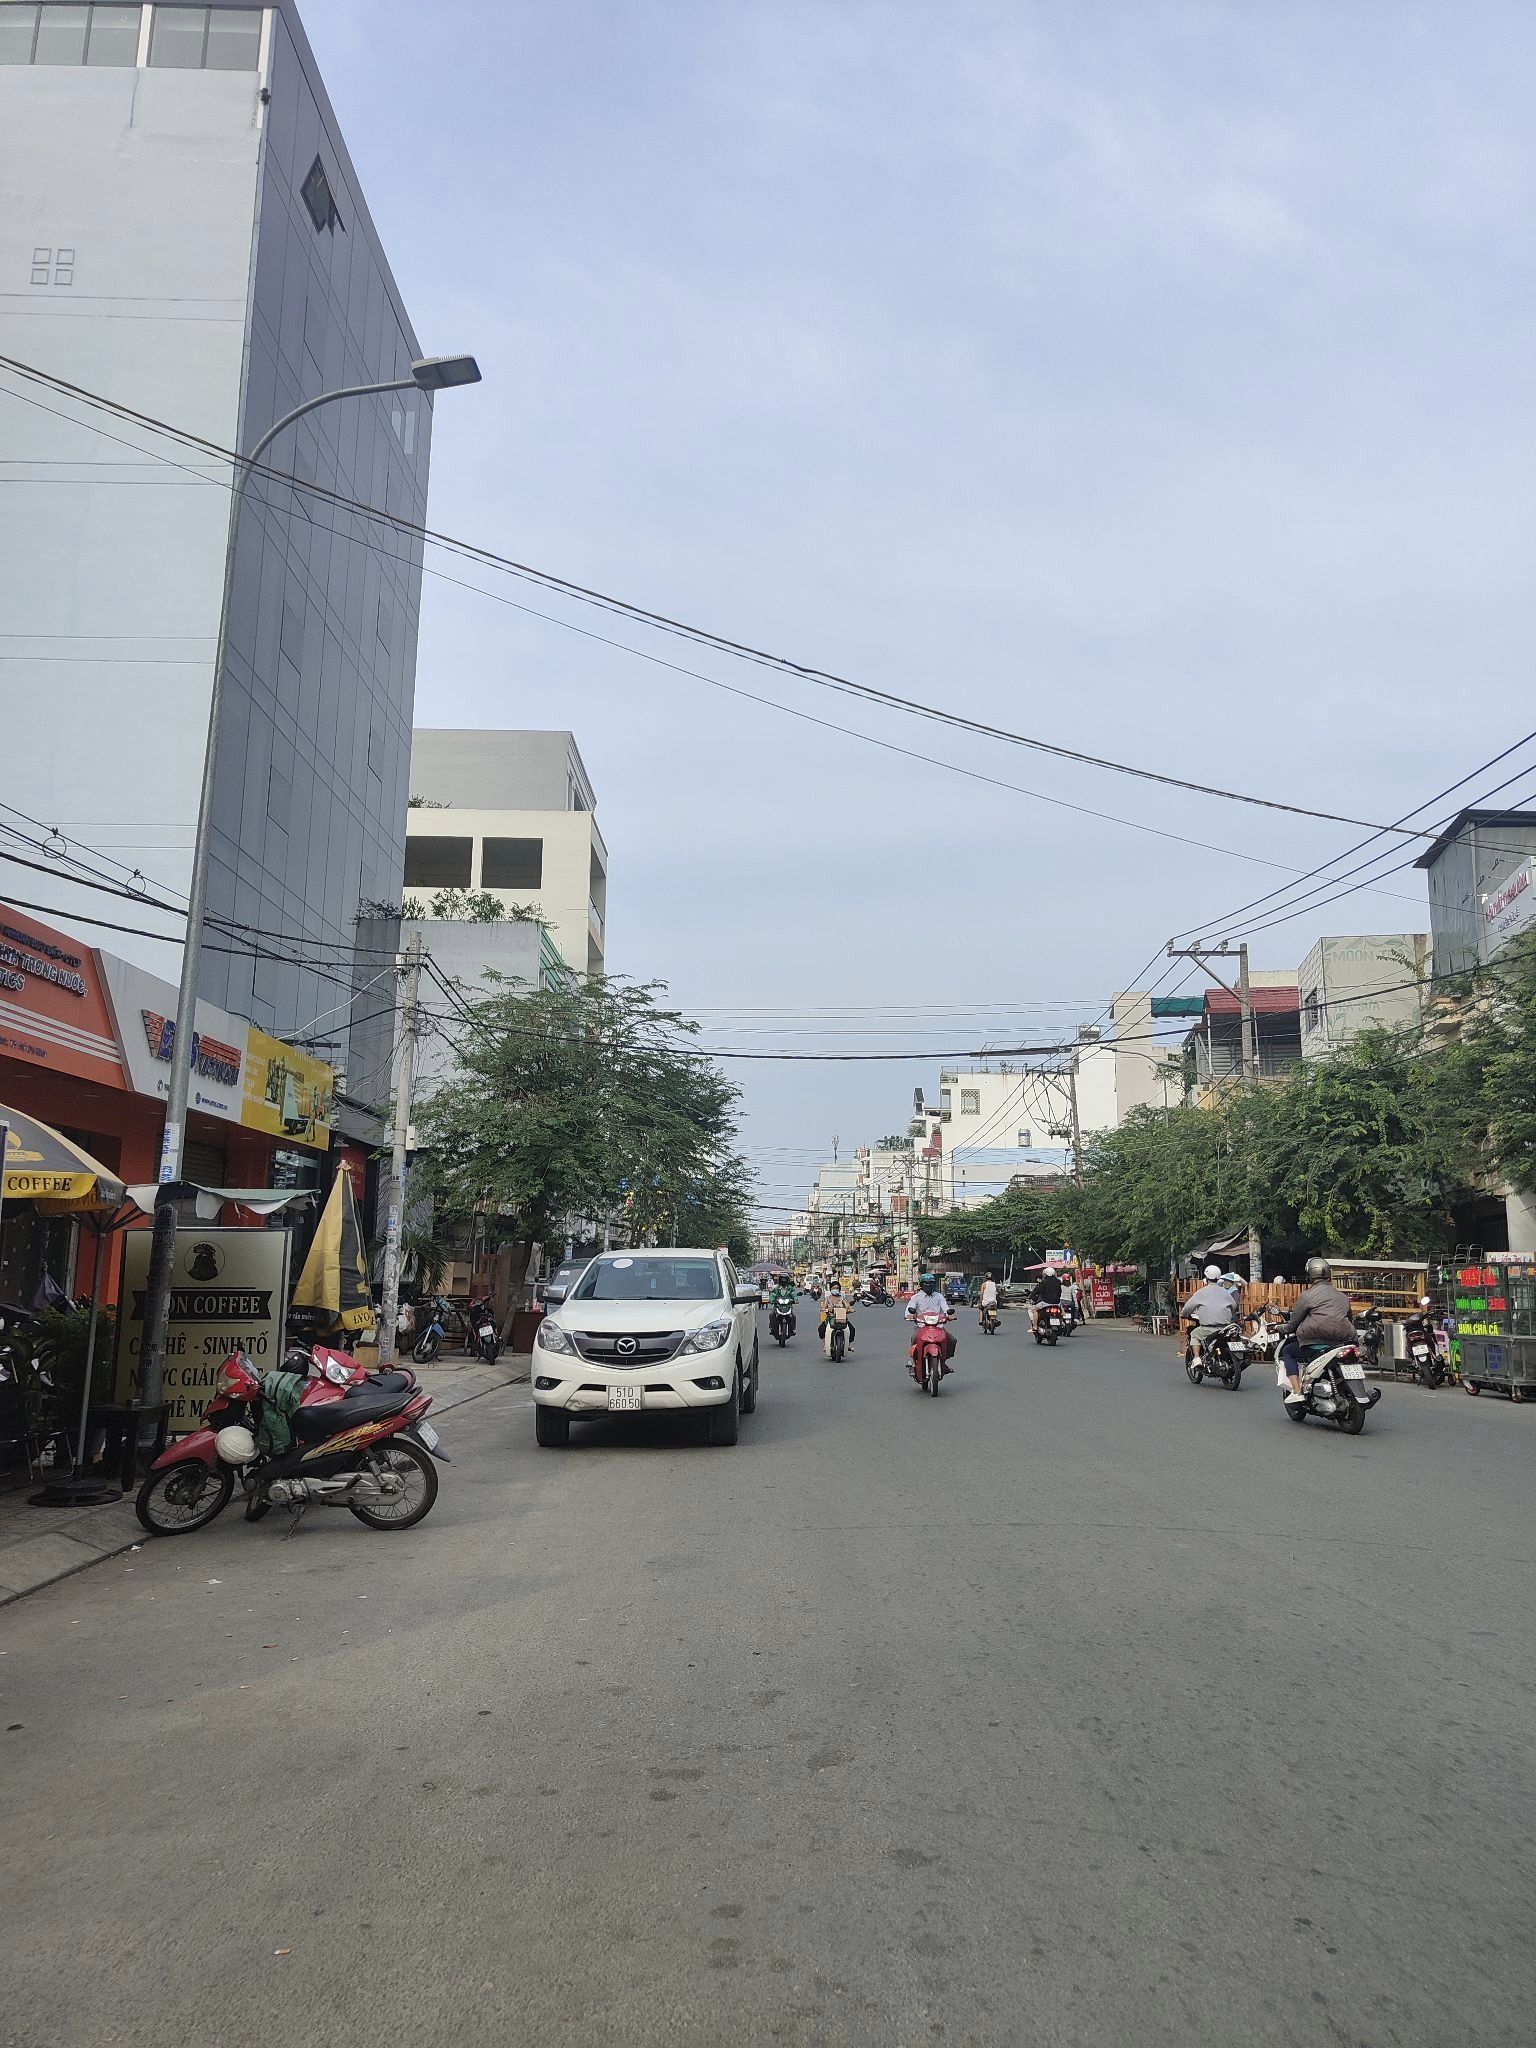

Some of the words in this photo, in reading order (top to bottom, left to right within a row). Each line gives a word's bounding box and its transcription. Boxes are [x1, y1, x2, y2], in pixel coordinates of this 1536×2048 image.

[1332, 950, 1373, 961] MOON
[22, 953, 57, 981] TRONG
[7, 1176, 73, 1192] COFFEE
[170, 1296, 189, 1314] ON
[193, 1296, 261, 1314] COFFEE
[1458, 1321, 1472, 1334] BÚN
[1473, 1321, 1488, 1334] CHẢ
[1489, 1322, 1498, 1336] CÁ
[166, 1332, 187, 1355] HÊ
[202, 1336, 241, 1355] SINH
[245, 1331, 269, 1355] TỐ
[181, 1363, 216, 1386] GIẢI
[616, 1388, 633, 1397] 51D
[610, 1399, 640, 1408] 660.50
